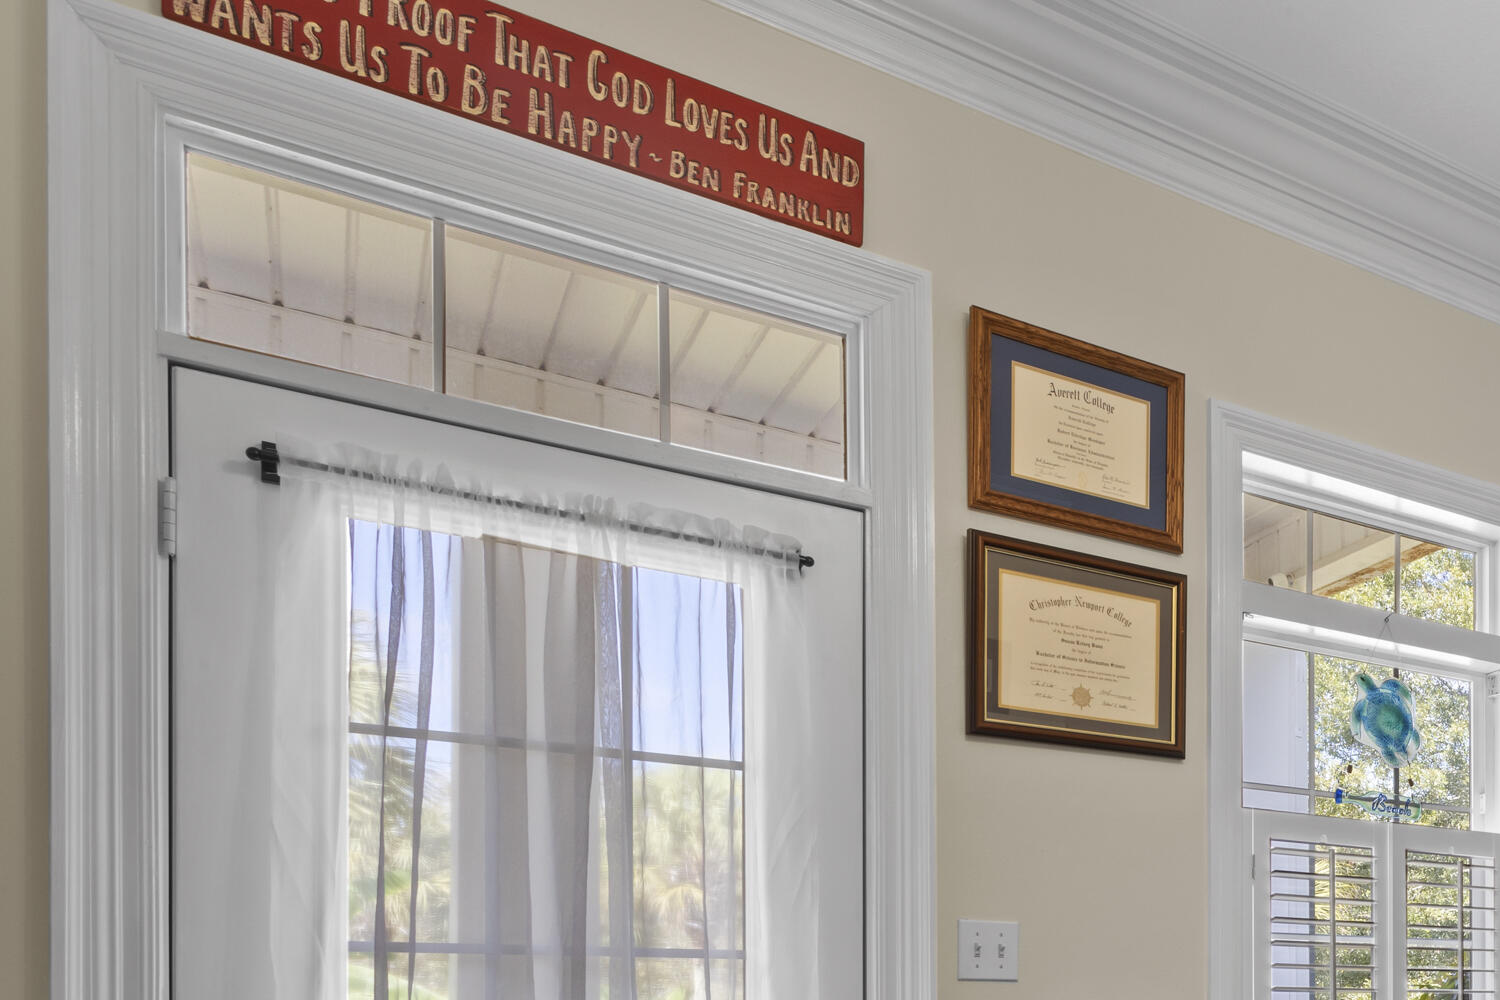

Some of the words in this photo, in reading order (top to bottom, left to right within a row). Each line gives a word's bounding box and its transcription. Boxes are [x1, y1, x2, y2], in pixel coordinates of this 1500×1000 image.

[527, 87, 642, 168] HAPPY
[733, 171, 852, 235] FRANKLIN
[1083, 390, 1115, 414] College
[1029, 595, 1072, 611] Christopher
[1074, 593, 1105, 613] Newport
[1106, 607, 1133, 627] College
[1371, 793, 1412, 816] Beach
